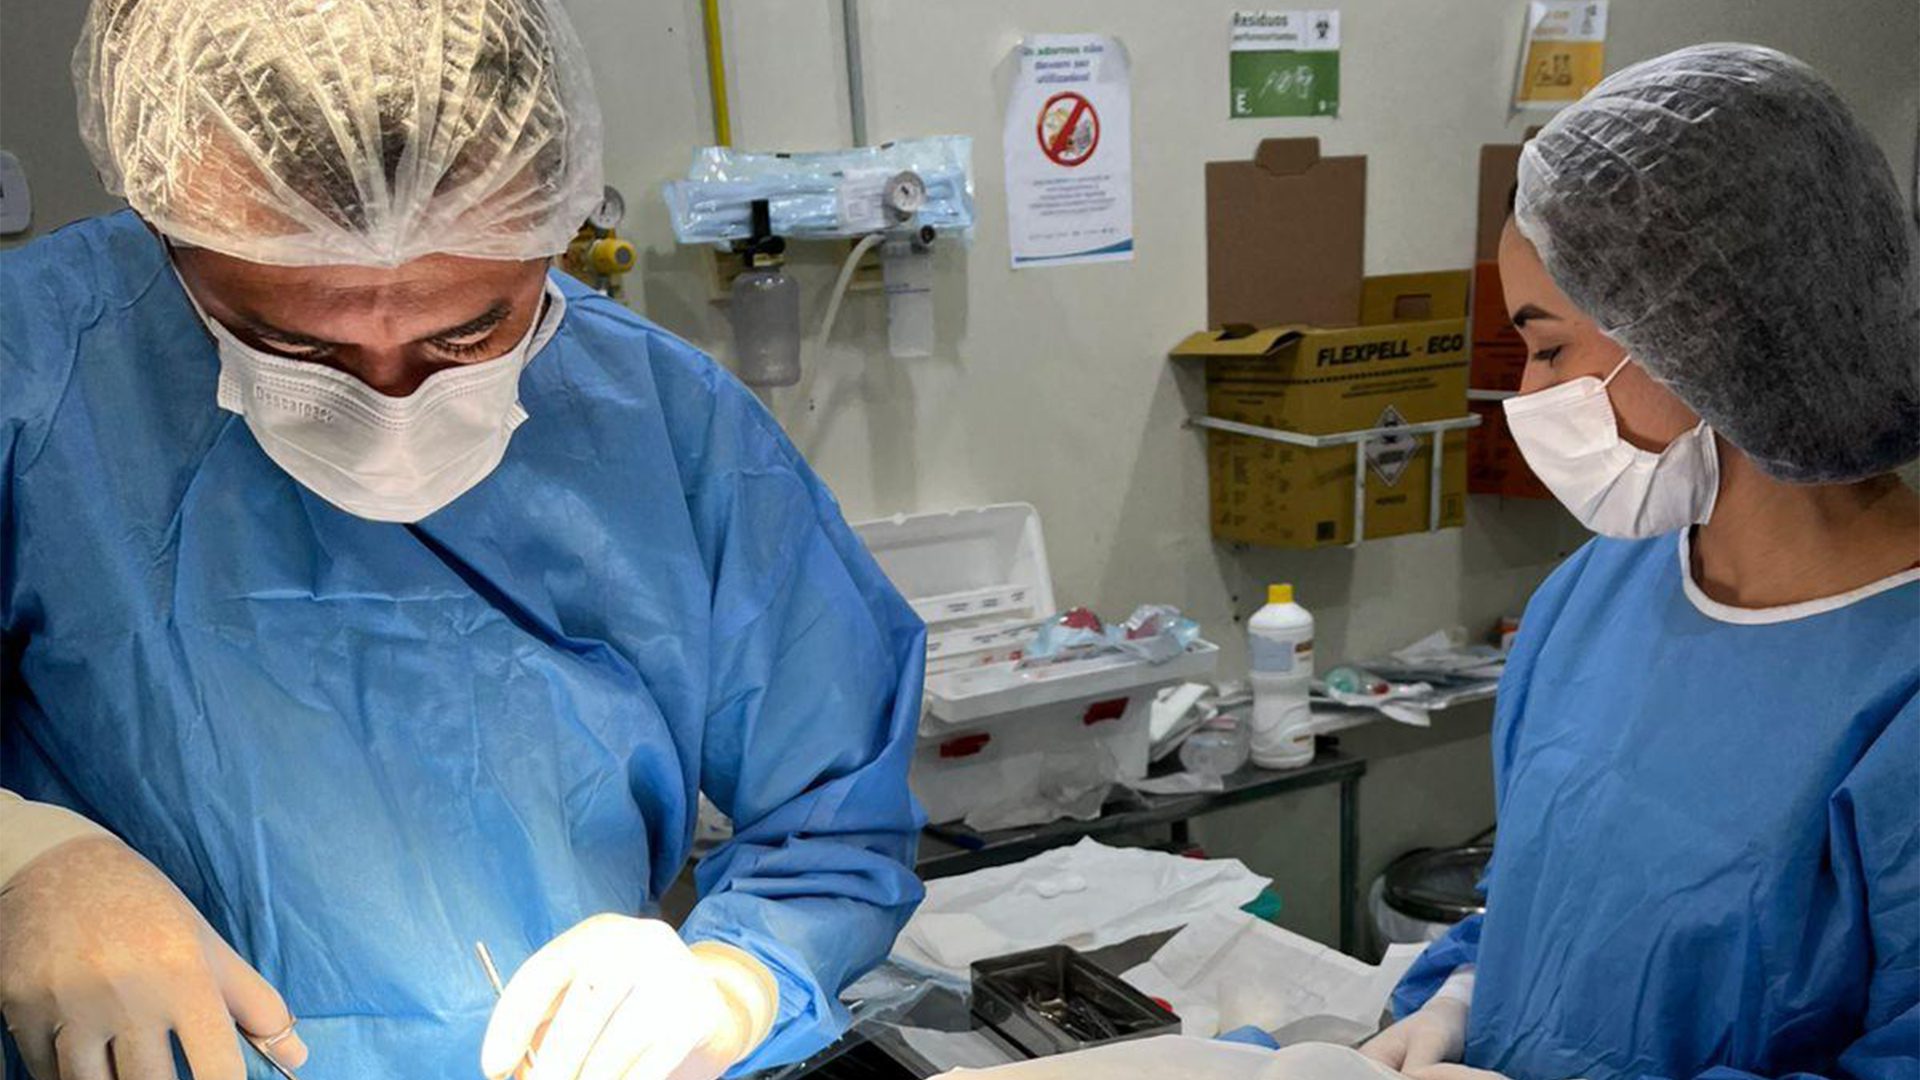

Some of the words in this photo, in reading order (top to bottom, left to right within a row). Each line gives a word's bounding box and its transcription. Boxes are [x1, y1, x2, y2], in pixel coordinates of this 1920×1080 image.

[1233, 12, 1288, 27] Resíduos
[1316, 339, 1411, 368] FLEXPELL
[1427, 334, 1465, 355] ECO
